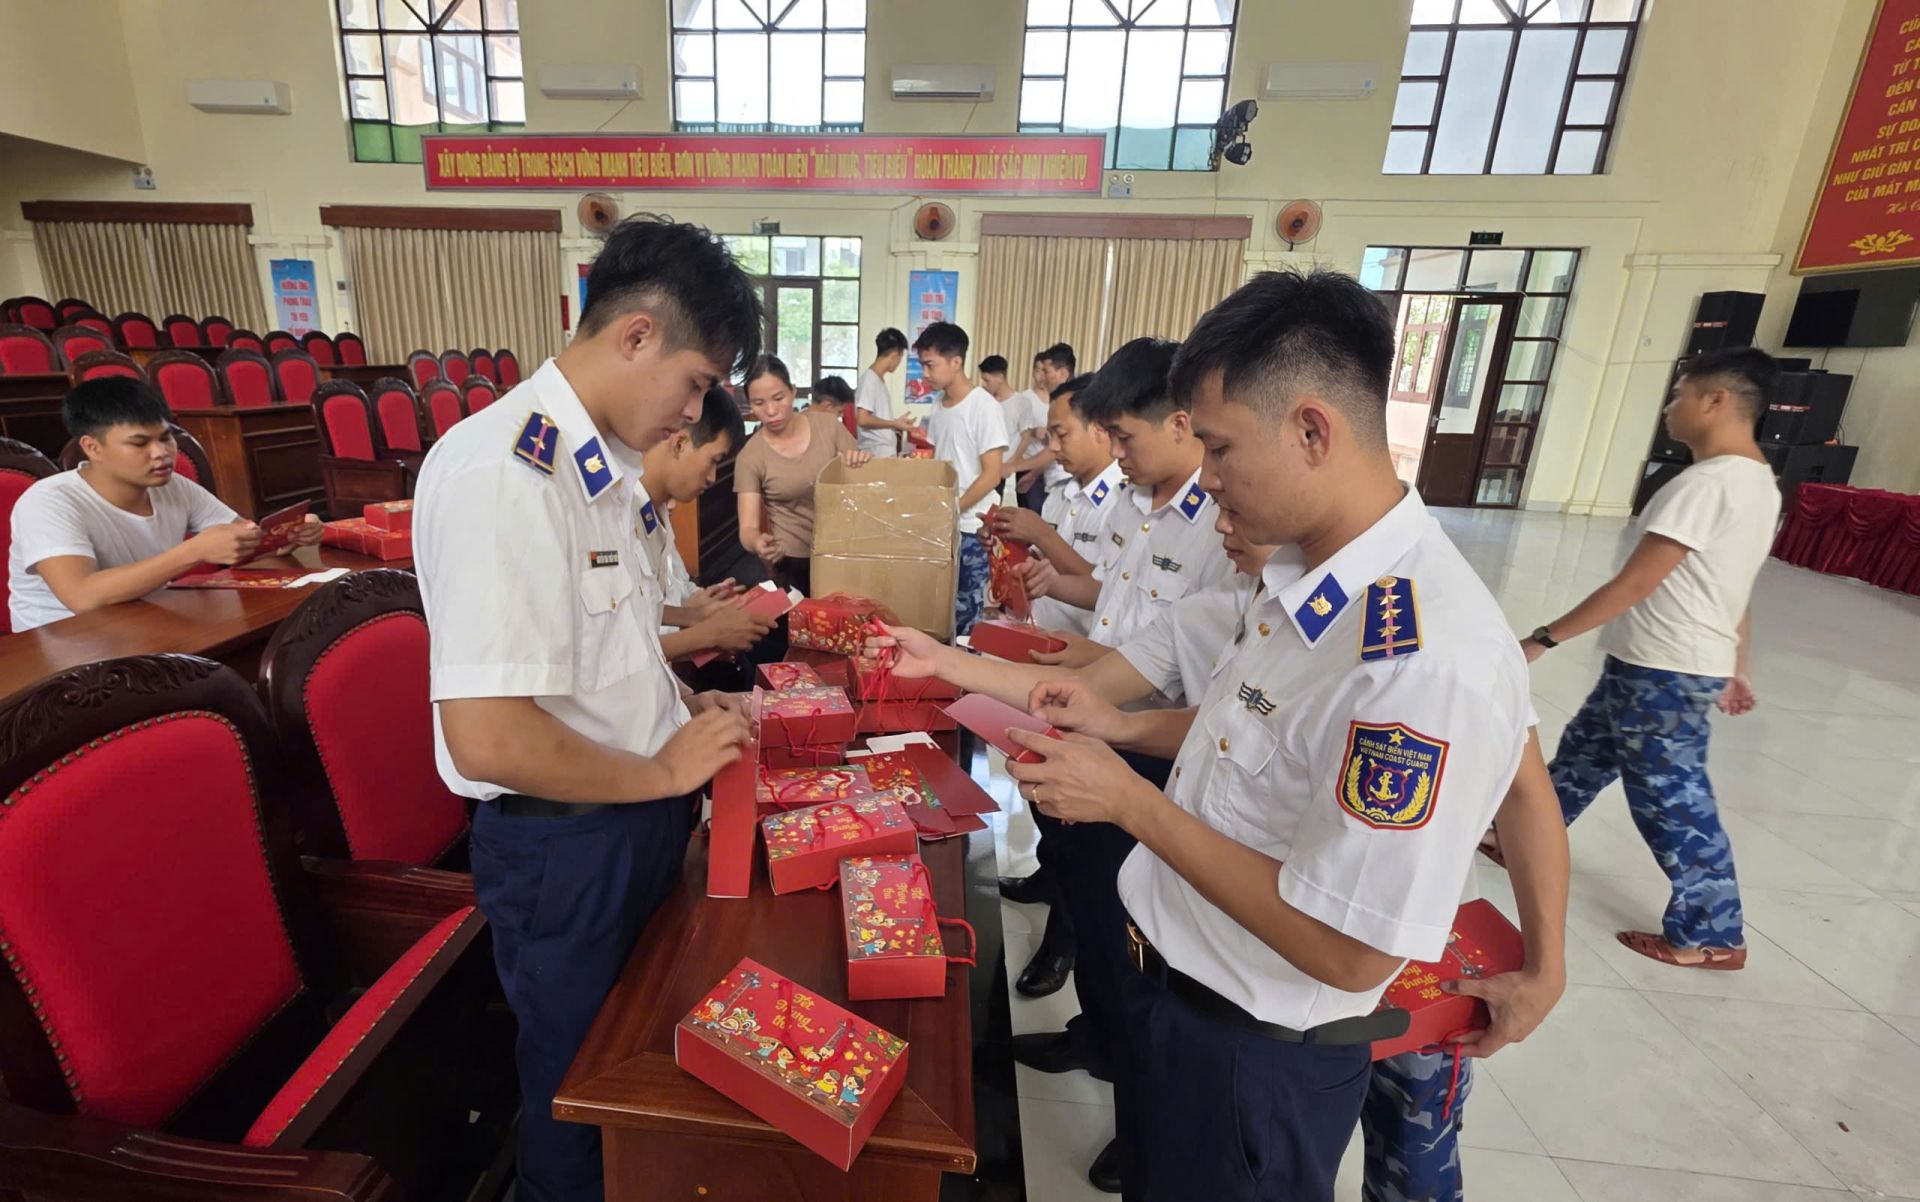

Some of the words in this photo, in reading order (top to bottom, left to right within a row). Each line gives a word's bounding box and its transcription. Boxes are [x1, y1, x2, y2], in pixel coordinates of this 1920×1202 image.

[1876, 121, 1898, 139] SỰ
[1850, 143, 1885, 164] NHẤT
[437, 147, 455, 177] XÂY
[456, 150, 481, 183] DỰNG
[481, 144, 507, 177] ĐẢNG
[507, 147, 520, 183] BỘ
[520, 152, 550, 177] TRONG
[551, 151, 575, 183] SẠCH
[575, 147, 600, 177] VỮNG
[601, 152, 629, 183] MẠNH
[629, 147, 649, 177] TIÊU
[706, 148, 730, 177] VỮNG
[732, 152, 759, 183] MẠNH
[761, 147, 785, 178] TOÀN
[914, 149, 941, 180] HOÀN
[942, 149, 974, 180] THÀNH
[974, 145, 1000, 180] XUẤT
[1000, 144, 1021, 180] SẮC
[1074, 154, 1088, 186] VỤ
[1833, 168, 1862, 186] NHƯ
[1844, 184, 1869, 202] CỦA
[1359, 736, 1375, 748] CẢNH
[1375, 742, 1387, 751] SÁT
[1387, 744, 1403, 756] BIỂN
[1403, 748, 1418, 760] VIỆT
[1418, 752, 1433, 762] NAM
[1384, 753, 1406, 765] COAST
[1406, 759, 1429, 769] GUARD
